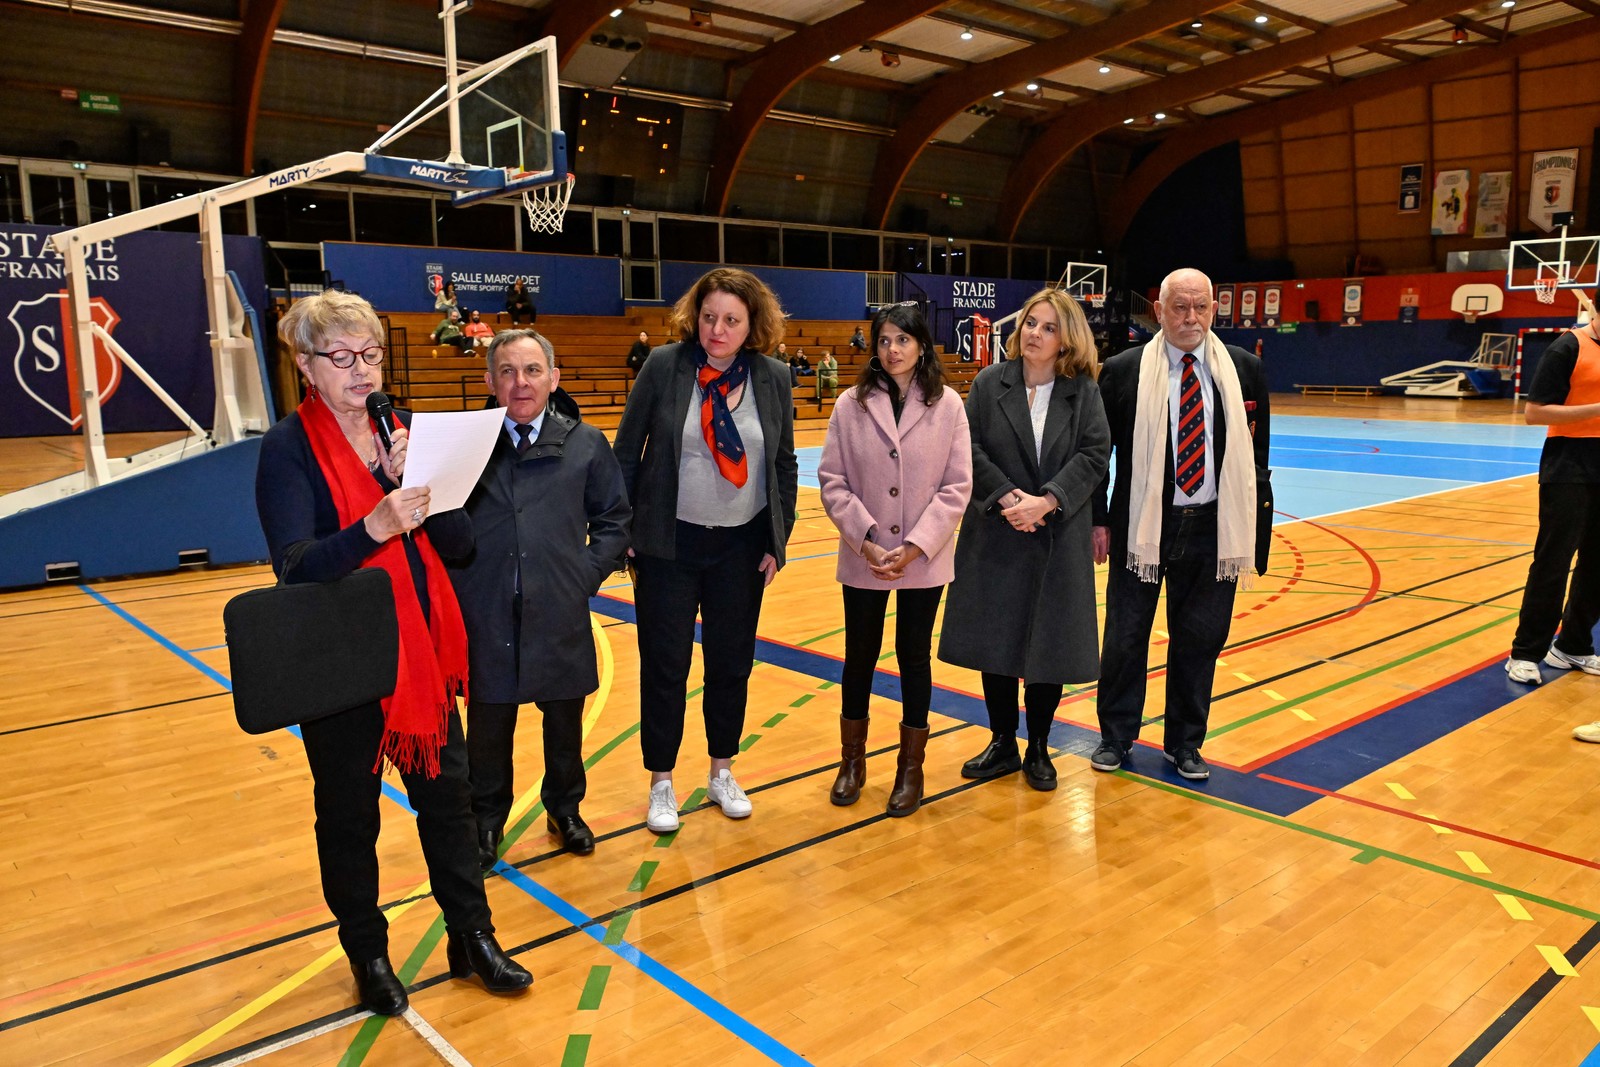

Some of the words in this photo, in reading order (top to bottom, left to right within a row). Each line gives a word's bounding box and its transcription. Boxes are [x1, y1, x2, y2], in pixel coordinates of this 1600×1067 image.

[269, 167, 310, 188] MARTY
[410, 164, 451, 181] MARTY
[0, 261, 120, 281] FRANAIS
[451, 271, 483, 283] SALLE
[484, 273, 540, 285] MARCADET
[953, 281, 996, 298] STADE
[962, 333, 986, 361] SF
